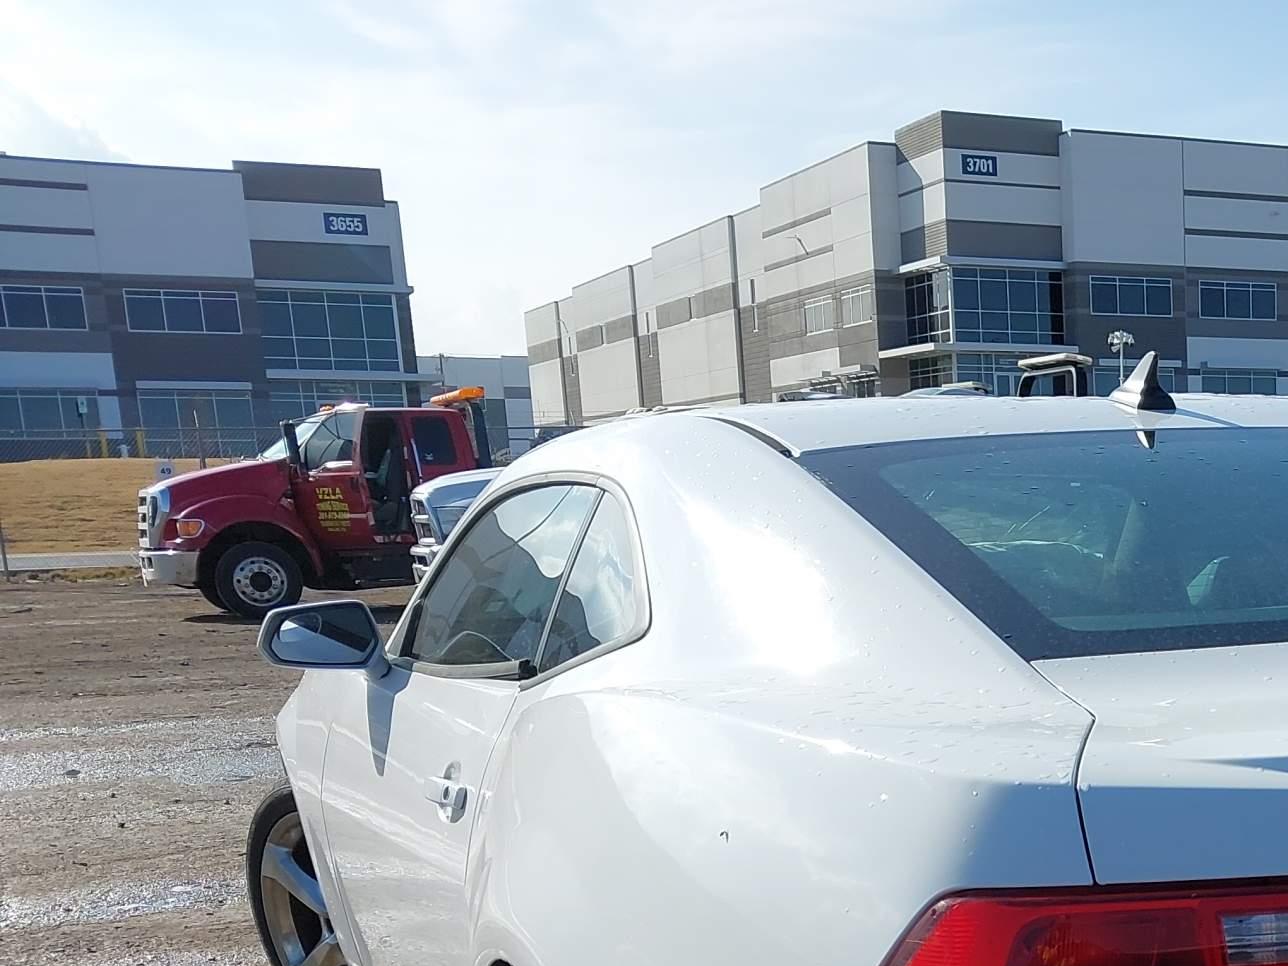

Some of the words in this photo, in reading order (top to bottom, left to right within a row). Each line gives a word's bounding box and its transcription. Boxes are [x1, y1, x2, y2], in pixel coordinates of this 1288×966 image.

[966, 157, 993, 173] 3701
[329, 216, 363, 232] 3655
[315, 487, 344, 500] VZLA
